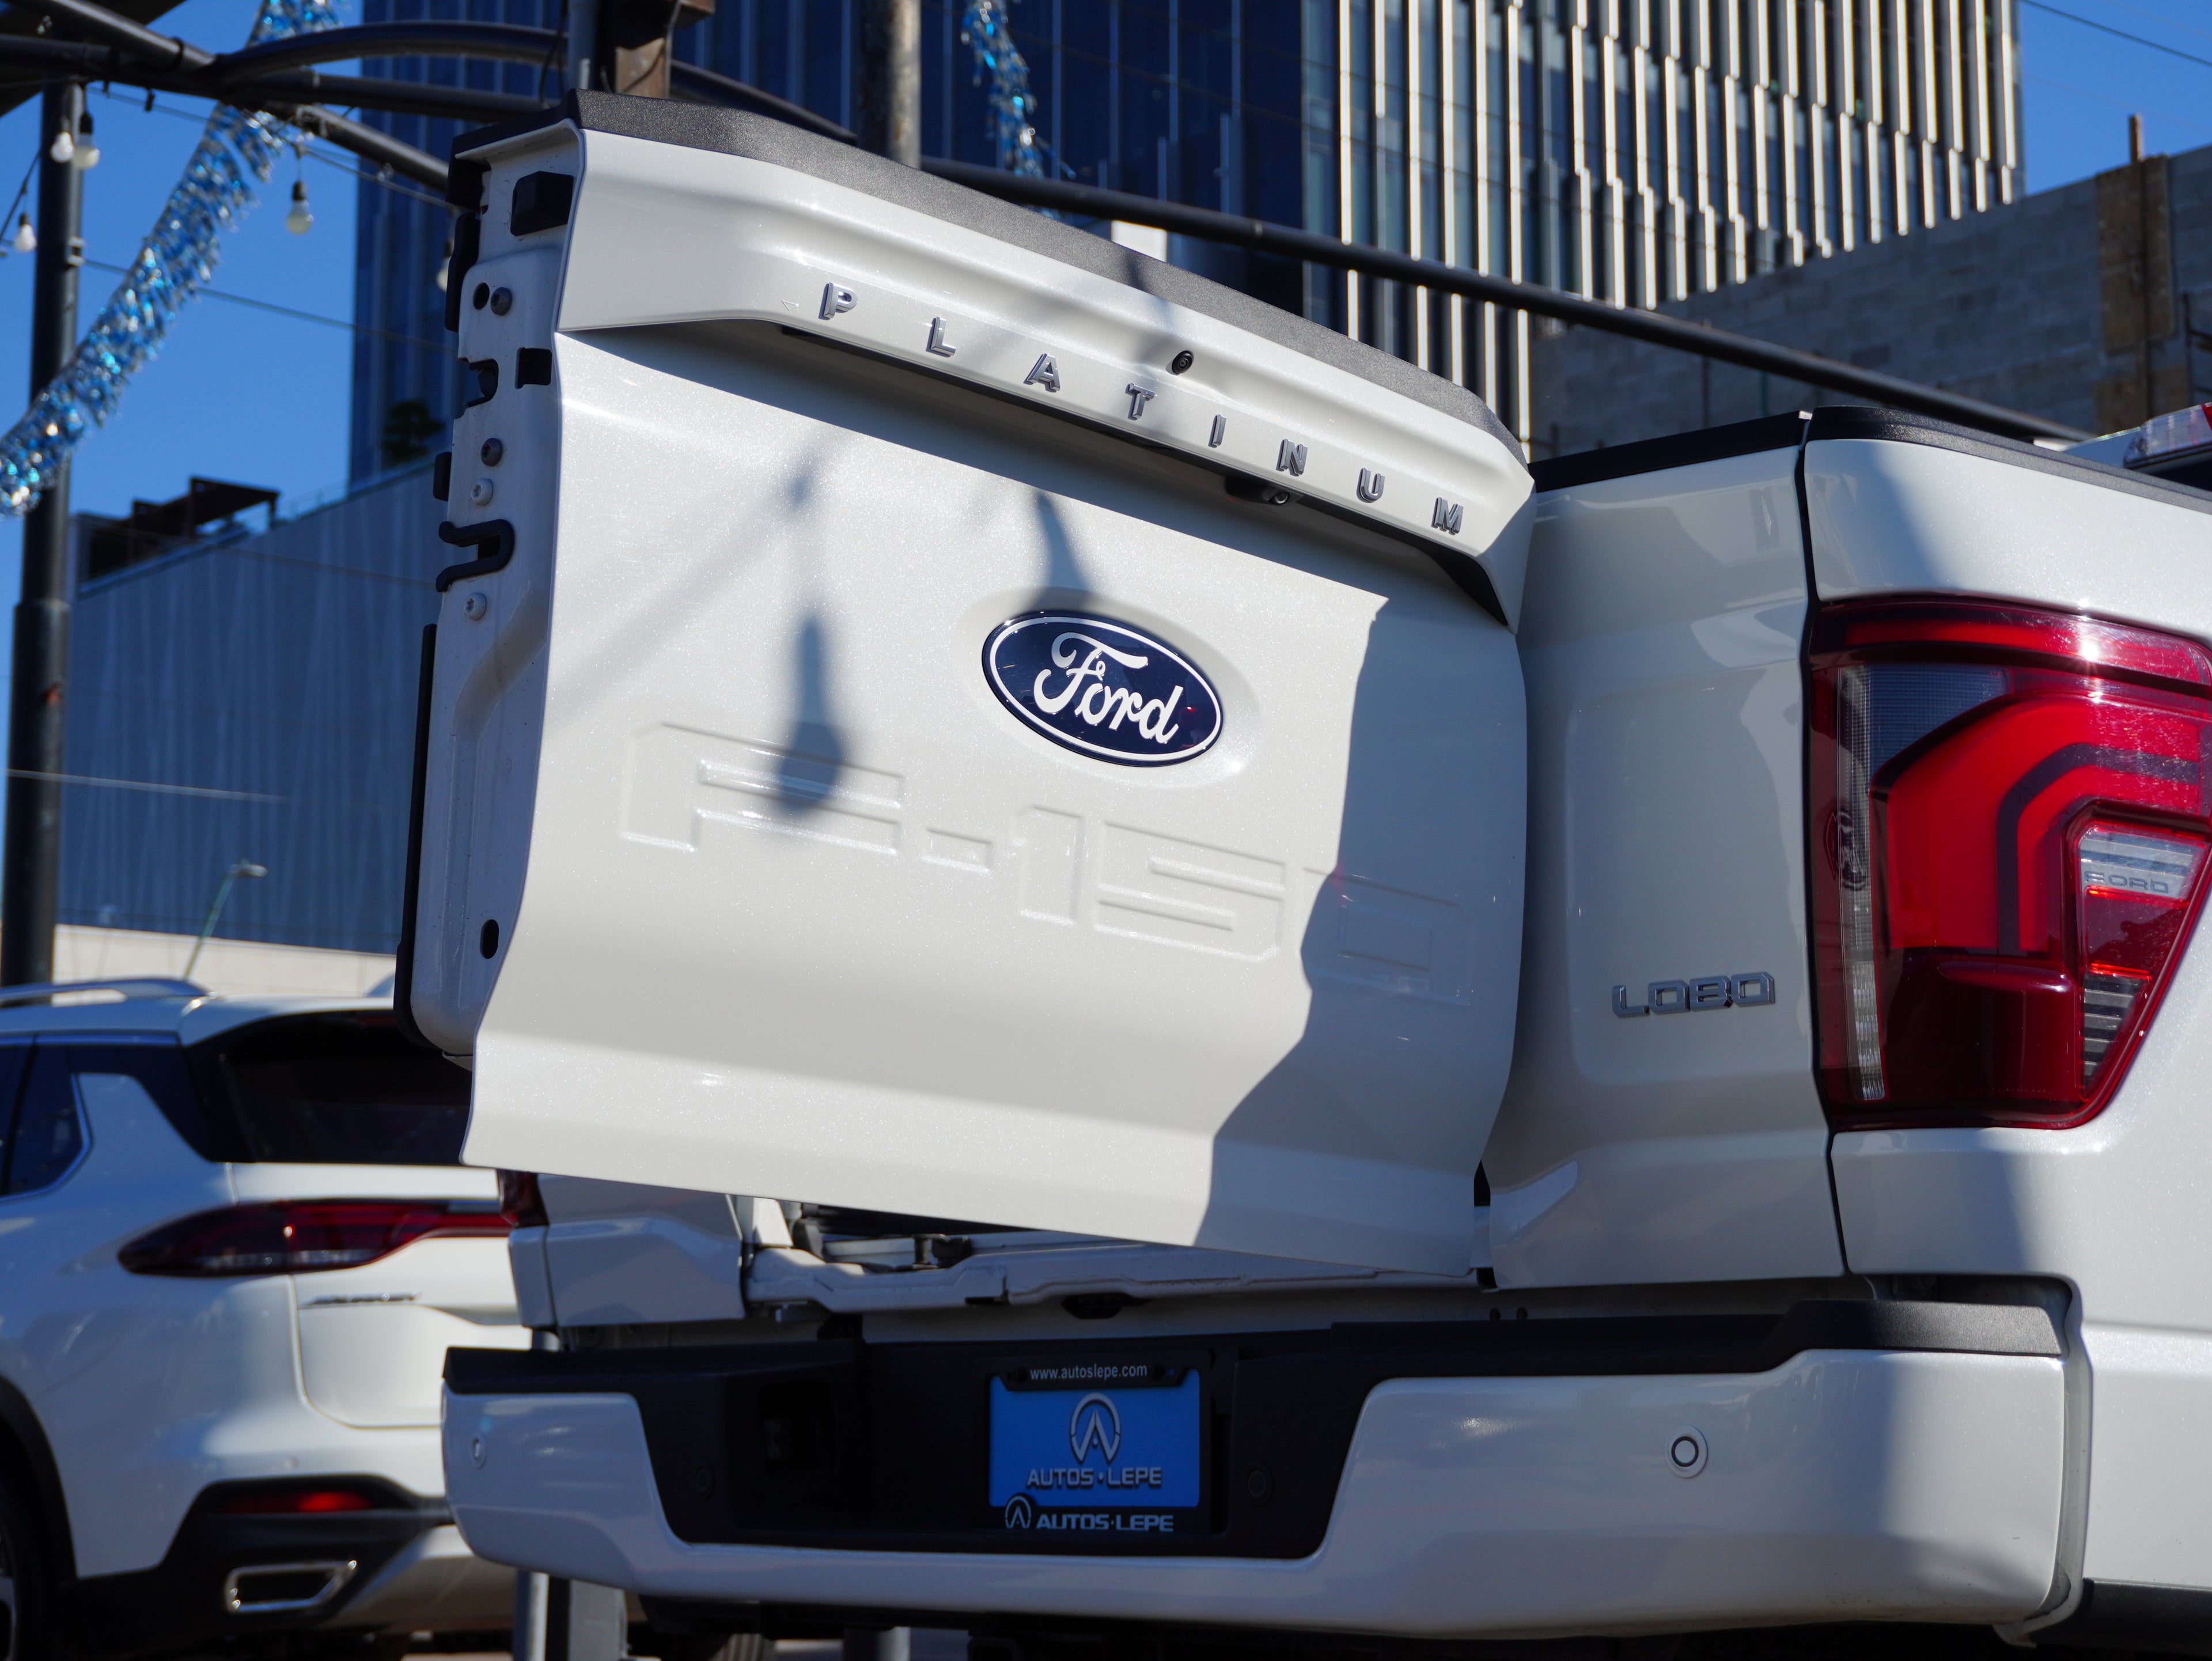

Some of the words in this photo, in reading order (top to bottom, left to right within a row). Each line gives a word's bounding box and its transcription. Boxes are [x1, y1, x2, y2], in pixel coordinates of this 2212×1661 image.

[820, 281, 1464, 536] PLATINUM
[1033, 631, 1184, 744] Ford
[620, 720, 1472, 1007] F-150
[2084, 871, 2169, 894] FORD
[1612, 971, 1775, 1018] LOBO
[1030, 1363, 1147, 1382] www.autoslepe.com
